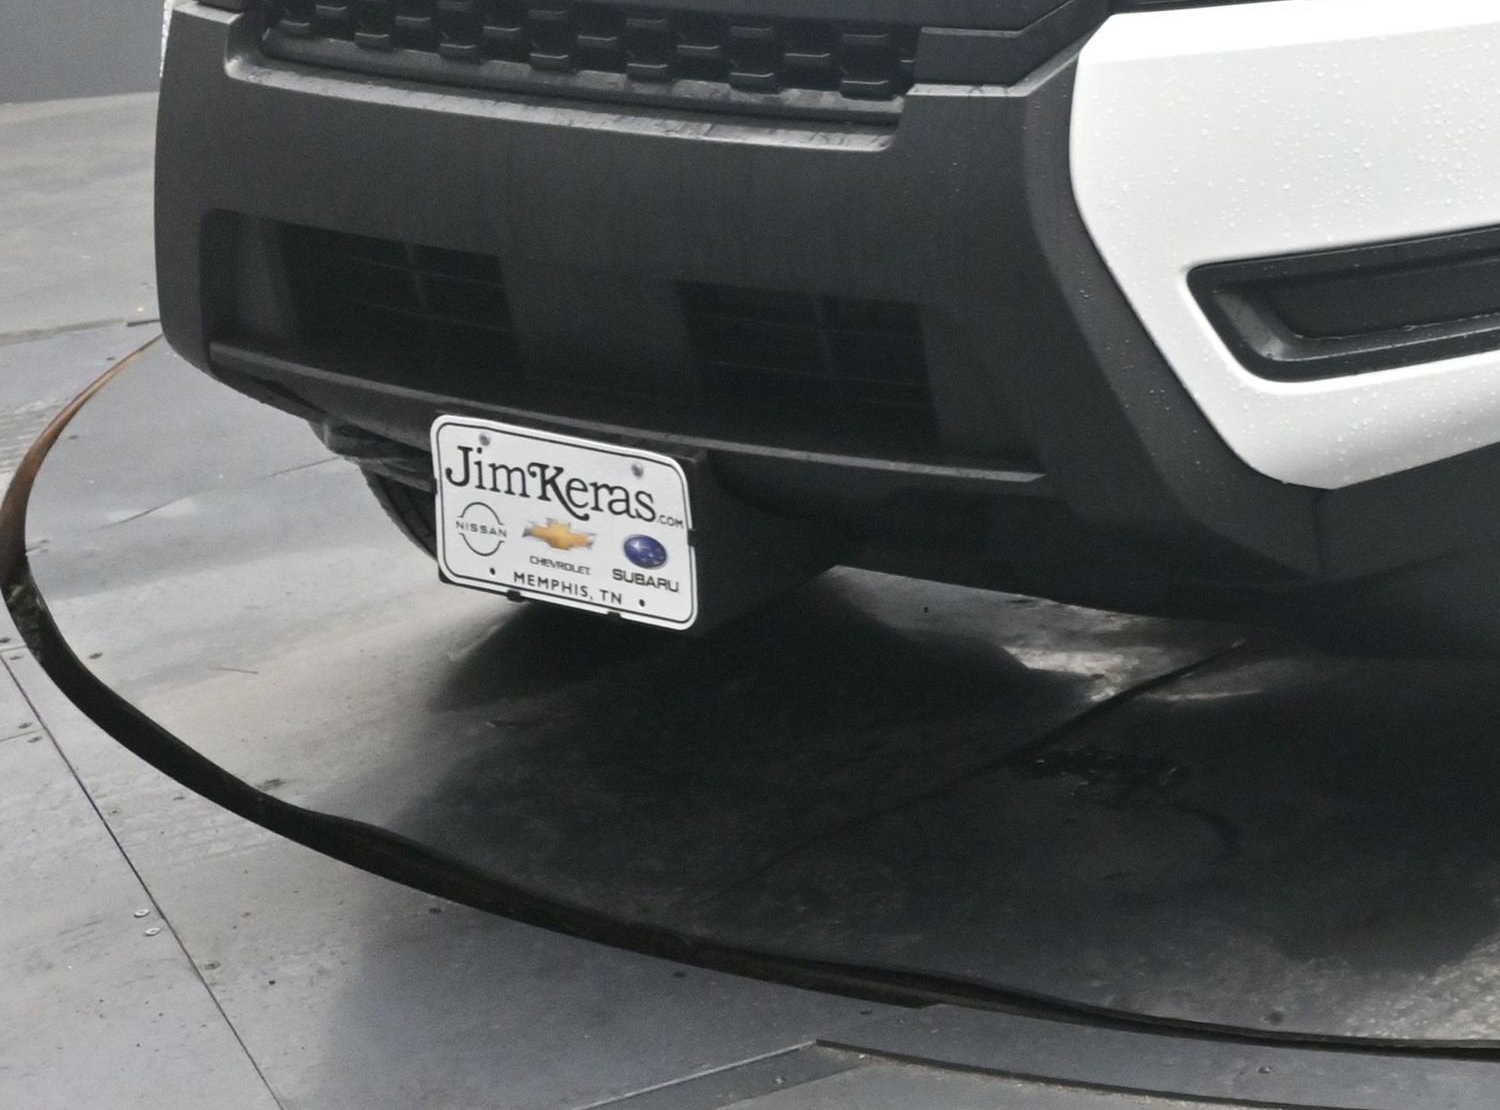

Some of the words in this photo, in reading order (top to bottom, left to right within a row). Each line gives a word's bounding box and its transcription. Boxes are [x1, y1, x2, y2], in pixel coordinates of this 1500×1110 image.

[455, 520, 508, 539] NISSAN
[529, 555, 591, 576] CHEVROLET
[513, 571, 594, 601] MEMPHIS,
[600, 589, 622, 605] TN
[612, 568, 679, 593] SUBARU
